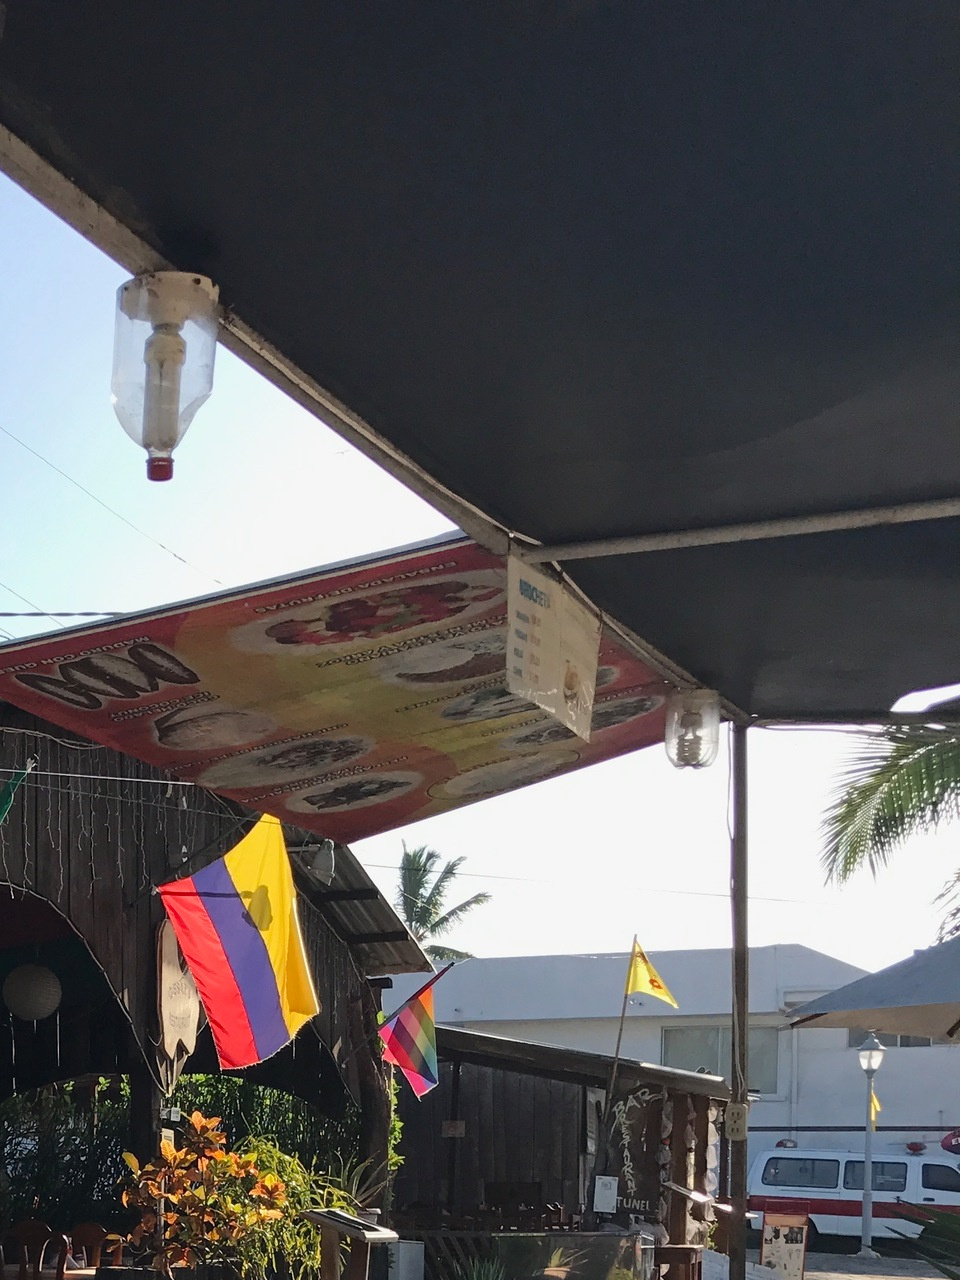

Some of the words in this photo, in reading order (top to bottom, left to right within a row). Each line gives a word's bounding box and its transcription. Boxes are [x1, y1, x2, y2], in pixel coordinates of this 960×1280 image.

[357, 560, 457, 590] ENSALADA
[252, 592, 326, 614] FRUTAS
[80, 635, 150, 656] MADURO
[40, 653, 76, 666] CON
[611, 1088, 661, 1128] BAR
